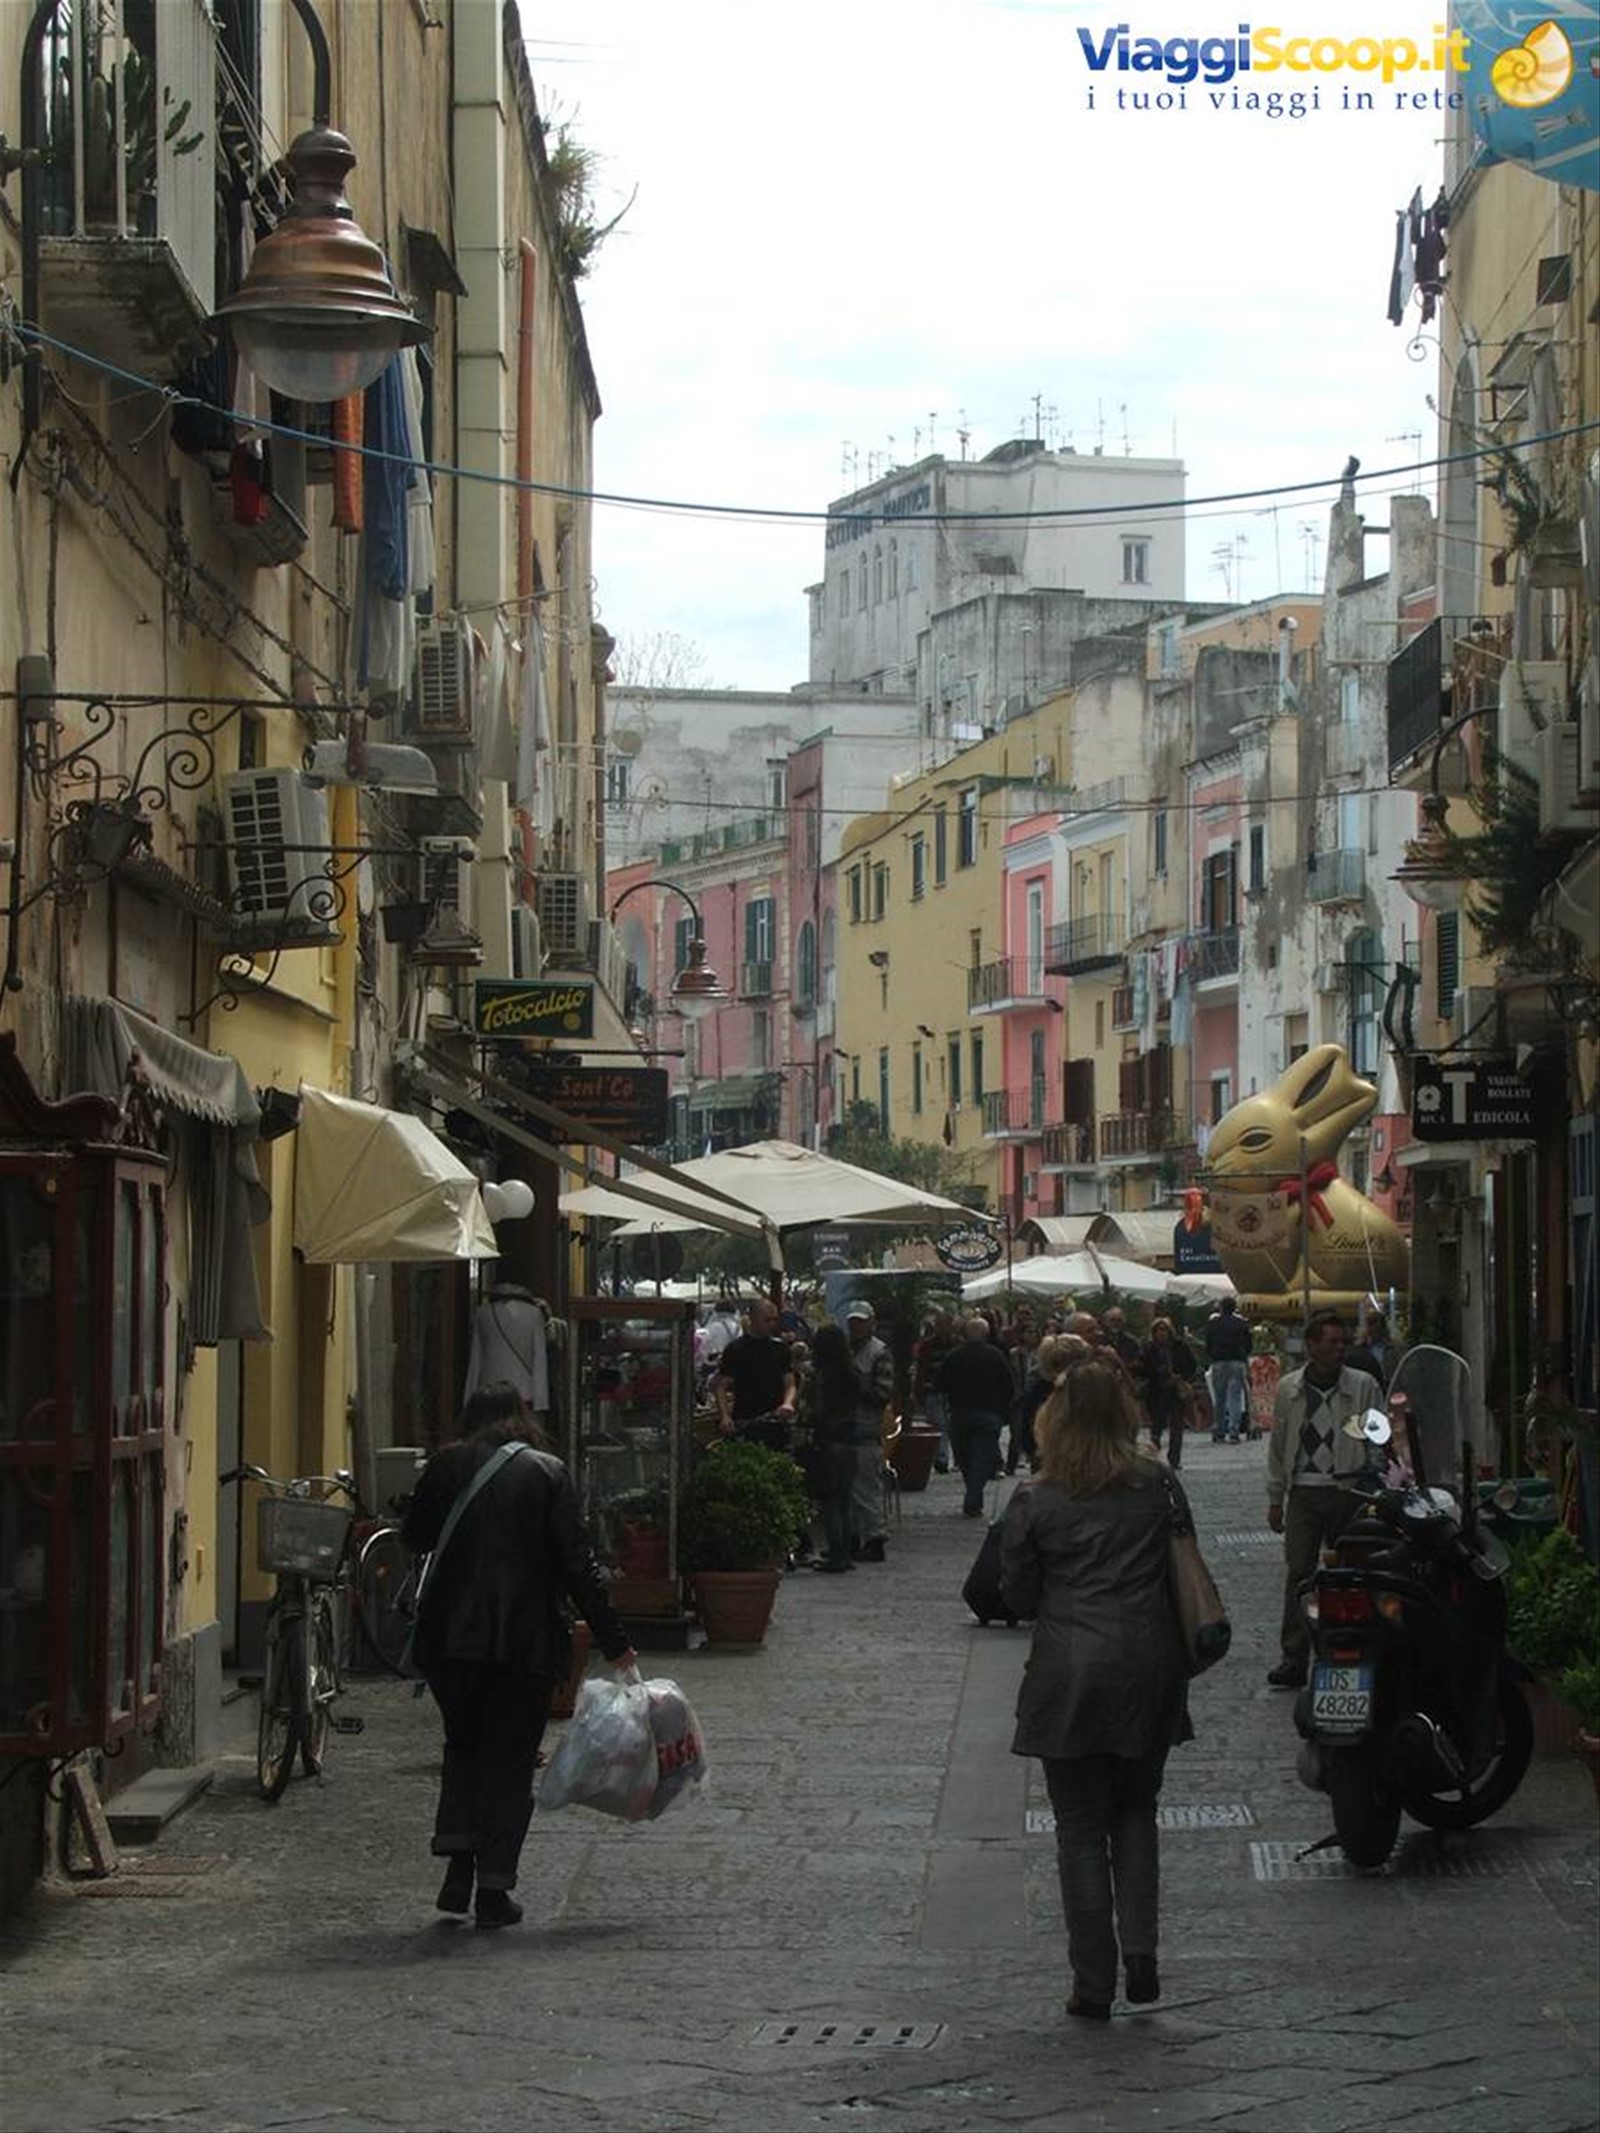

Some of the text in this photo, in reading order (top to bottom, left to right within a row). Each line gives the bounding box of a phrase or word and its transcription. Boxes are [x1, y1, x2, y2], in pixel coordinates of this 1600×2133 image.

[481, 987, 586, 1032] Totocalcio
[1443, 1071, 1475, 1124] T
[1473, 1111, 1530, 1124] EDICOLA
[1316, 1695, 1368, 1715] 48282
